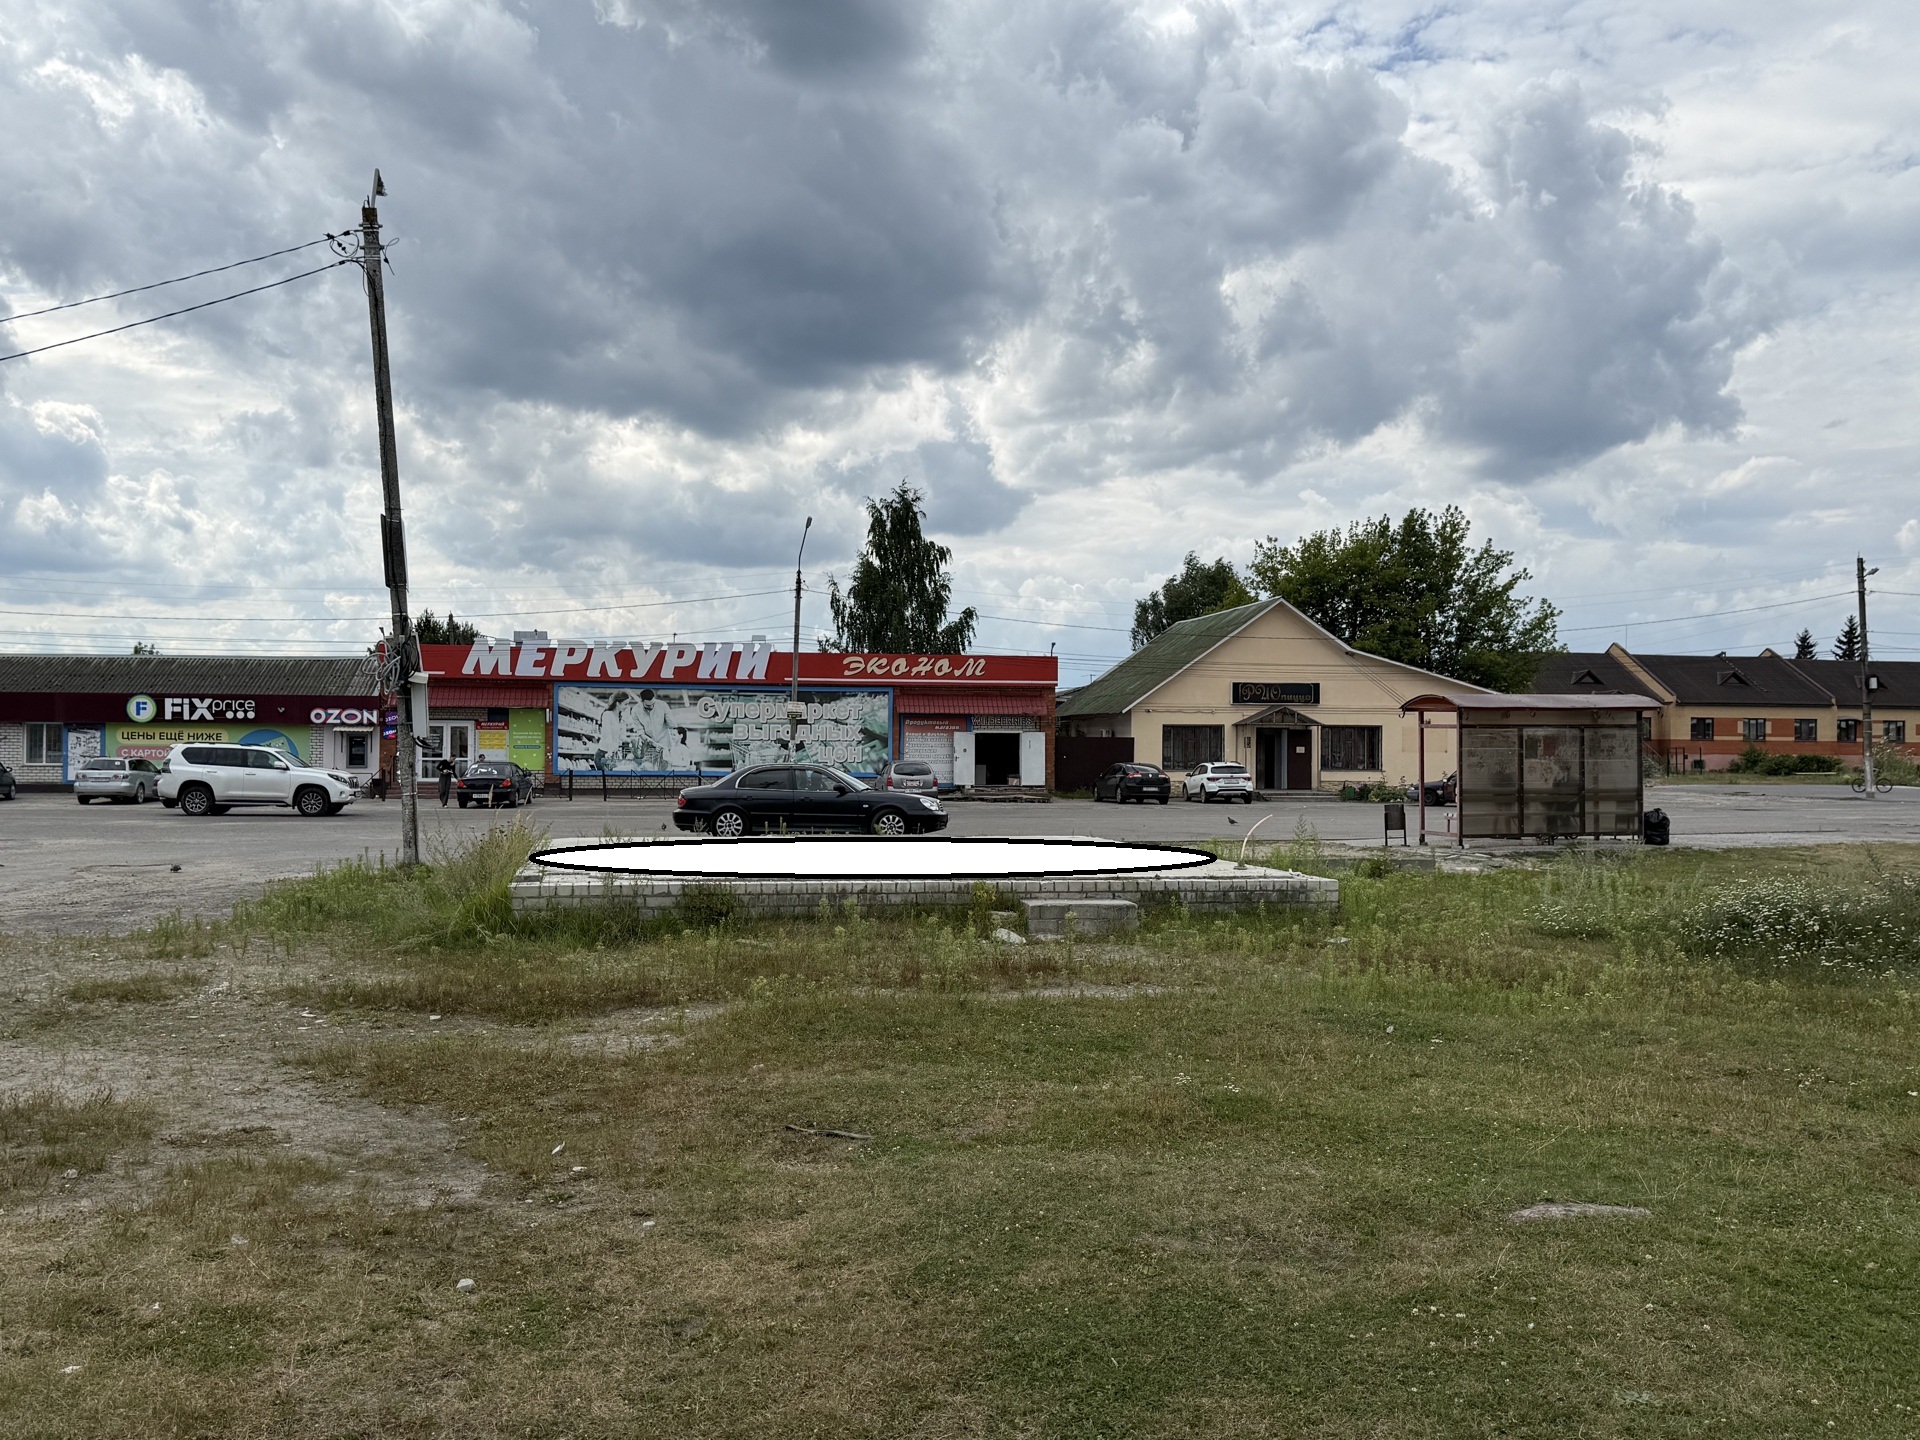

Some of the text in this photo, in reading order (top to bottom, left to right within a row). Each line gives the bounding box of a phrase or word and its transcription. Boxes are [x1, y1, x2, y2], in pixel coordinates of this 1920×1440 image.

[842, 655, 986, 677] ЭКОНОМ
[135, 701, 148, 716] F
[212, 699, 255, 713] price
[309, 707, 379, 725] OZON
[121, 730, 223, 742] ЦЕНЫ ЕЩЁ НИЖЕ
[732, 723, 863, 743] выгодных
[121, 748, 128, 757] С
